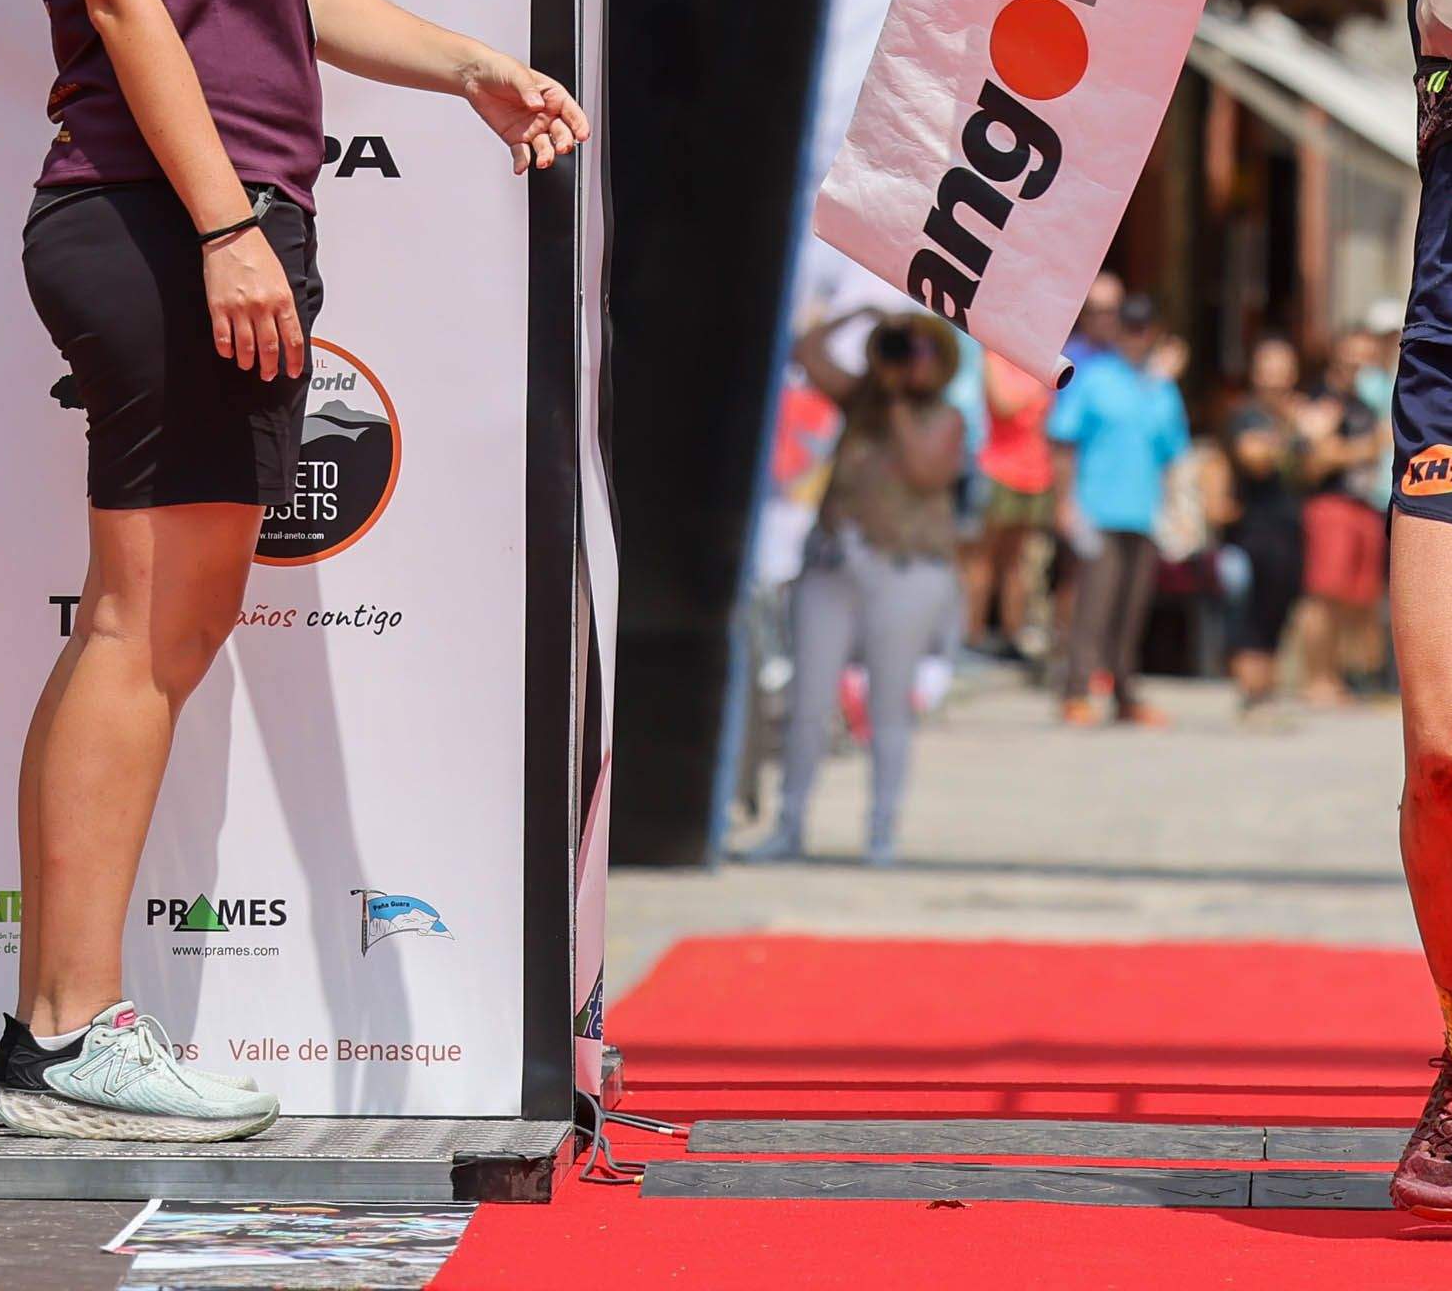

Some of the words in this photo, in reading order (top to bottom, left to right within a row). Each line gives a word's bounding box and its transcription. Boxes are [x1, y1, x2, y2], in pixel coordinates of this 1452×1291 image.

[294, 460, 340, 491] ETO
[305, 601, 403, 636] contigo
[3, 942, 19, 955] de
[171, 945, 281, 959] www.prames.com
[227, 1037, 290, 1063] Valle
[298, 1037, 330, 1063] de
[336, 1038, 462, 1070] Benasque
